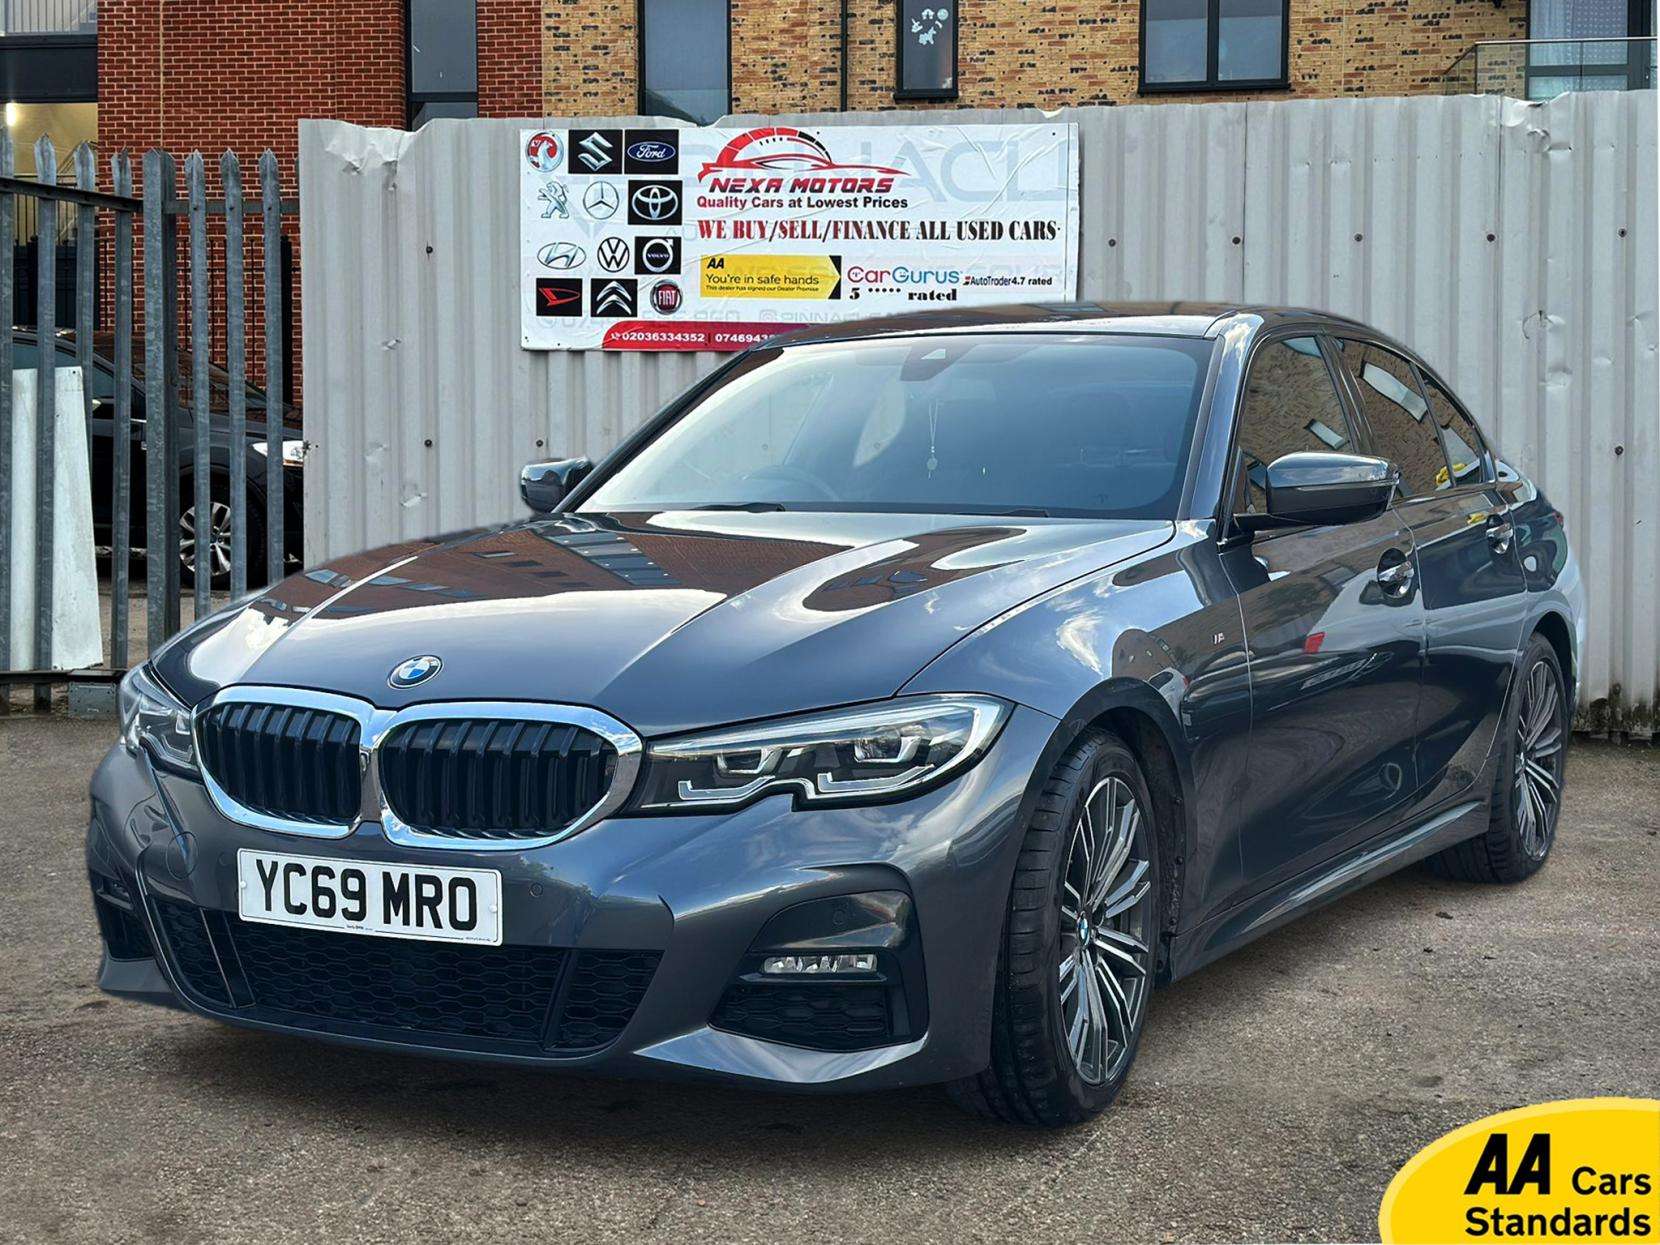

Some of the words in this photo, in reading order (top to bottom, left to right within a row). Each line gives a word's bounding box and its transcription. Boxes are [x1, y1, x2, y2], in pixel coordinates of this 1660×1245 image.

[636, 143, 666, 158] Ford
[708, 178, 784, 193] NEXA
[789, 178, 895, 193] MOTORS
[697, 196, 747, 210] Quality
[751, 196, 784, 208] Cars
[788, 197, 803, 208] at
[807, 196, 859, 208] Lowest
[863, 196, 908, 208] Prices
[697, 220, 727, 239] WE
[916, 220, 951, 240] ALL
[956, 220, 1004, 240] USED
[706, 257, 725, 269] AA
[706, 273, 741, 284] You're
[743, 273, 755, 284] in
[757, 273, 781, 285] safe
[784, 274, 820, 285] hands
[847, 266, 960, 284] CarGurus
[1027, 277, 1053, 286] rated
[658, 289, 677, 306] FIAT
[849, 287, 861, 300] 5
[908, 288, 958, 301] rated
[622, 332, 705, 342] 02036334352
[256, 859, 367, 922] YC69
[382, 871, 478, 932] MRO
